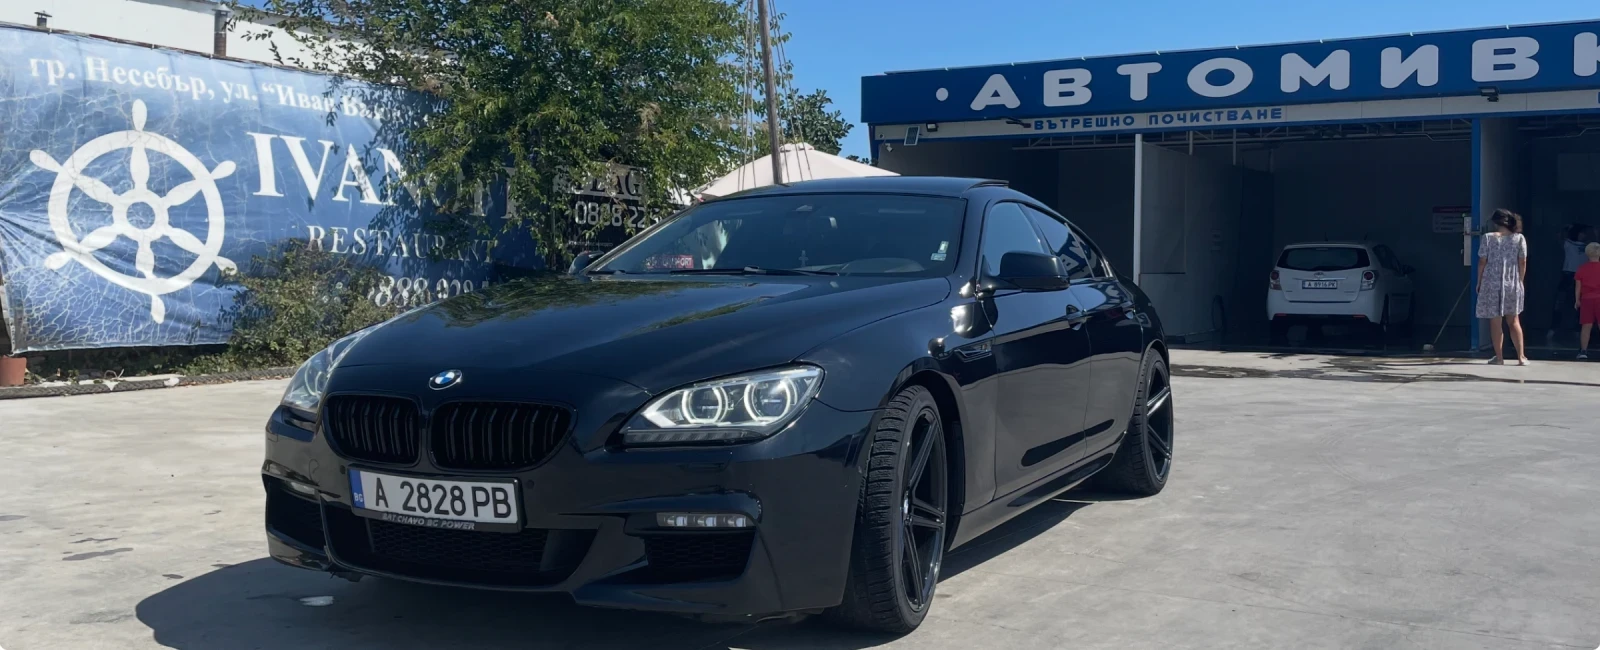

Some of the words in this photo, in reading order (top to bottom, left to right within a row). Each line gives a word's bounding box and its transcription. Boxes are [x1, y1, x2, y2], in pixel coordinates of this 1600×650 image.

[29, 58, 76, 86] гр.
[85, 56, 215, 100] Несебър,
[220, 80, 258, 103] ул.
[1034, 115, 1135, 131] ВЪТРЕШНО
[1149, 107, 1283, 126] ПОЧИСТВАНЕ
[307, 225, 498, 263] RESTAURNT
[367, 275, 431, 308] 888
[354, 492, 363, 502] BG
[375, 477, 389, 508] A
[397, 515, 424, 526] CHAVO
[440, 520, 475, 531] POWER
